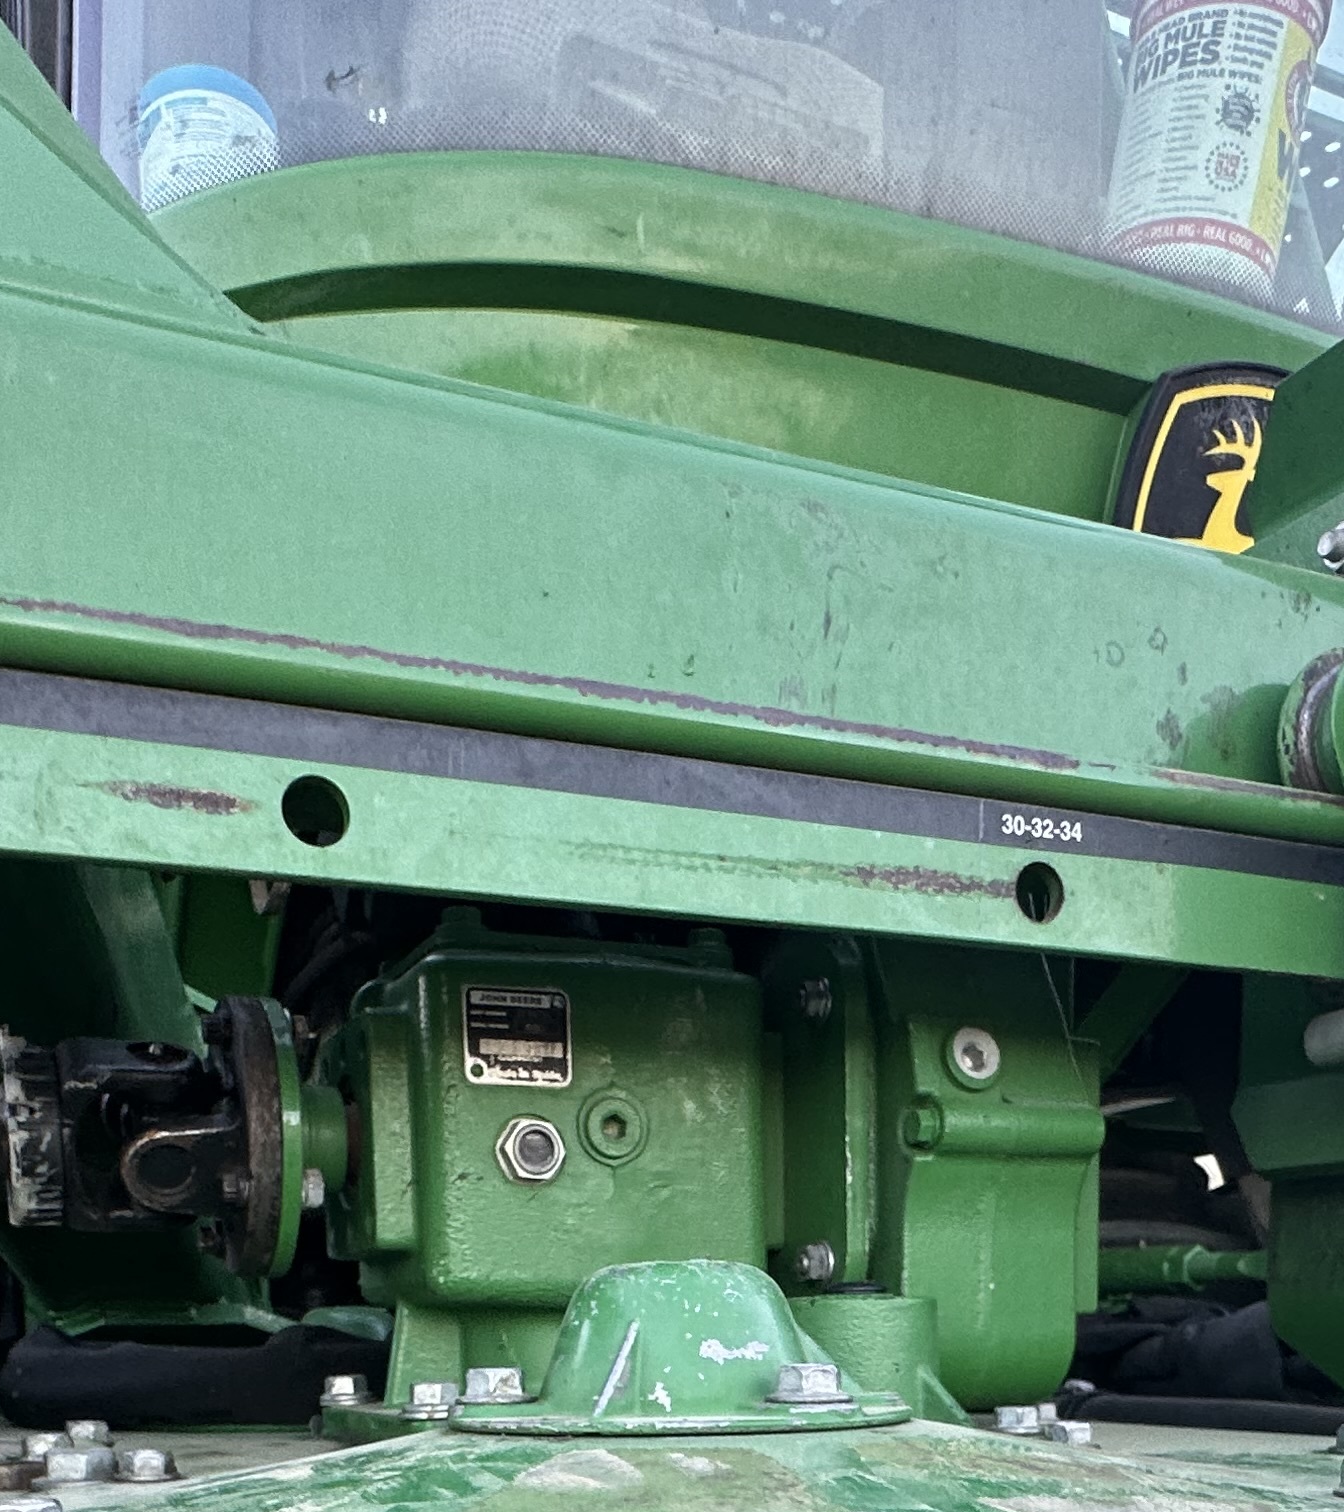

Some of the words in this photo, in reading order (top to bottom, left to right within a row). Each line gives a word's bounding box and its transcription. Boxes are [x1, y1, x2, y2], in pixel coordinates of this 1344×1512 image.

[1165, 20, 1227, 49] MULE
[1134, 39, 1221, 93] WIPES
[1203, 225, 1226, 242] REAL
[1001, 813, 1083, 843] 30-32-34
